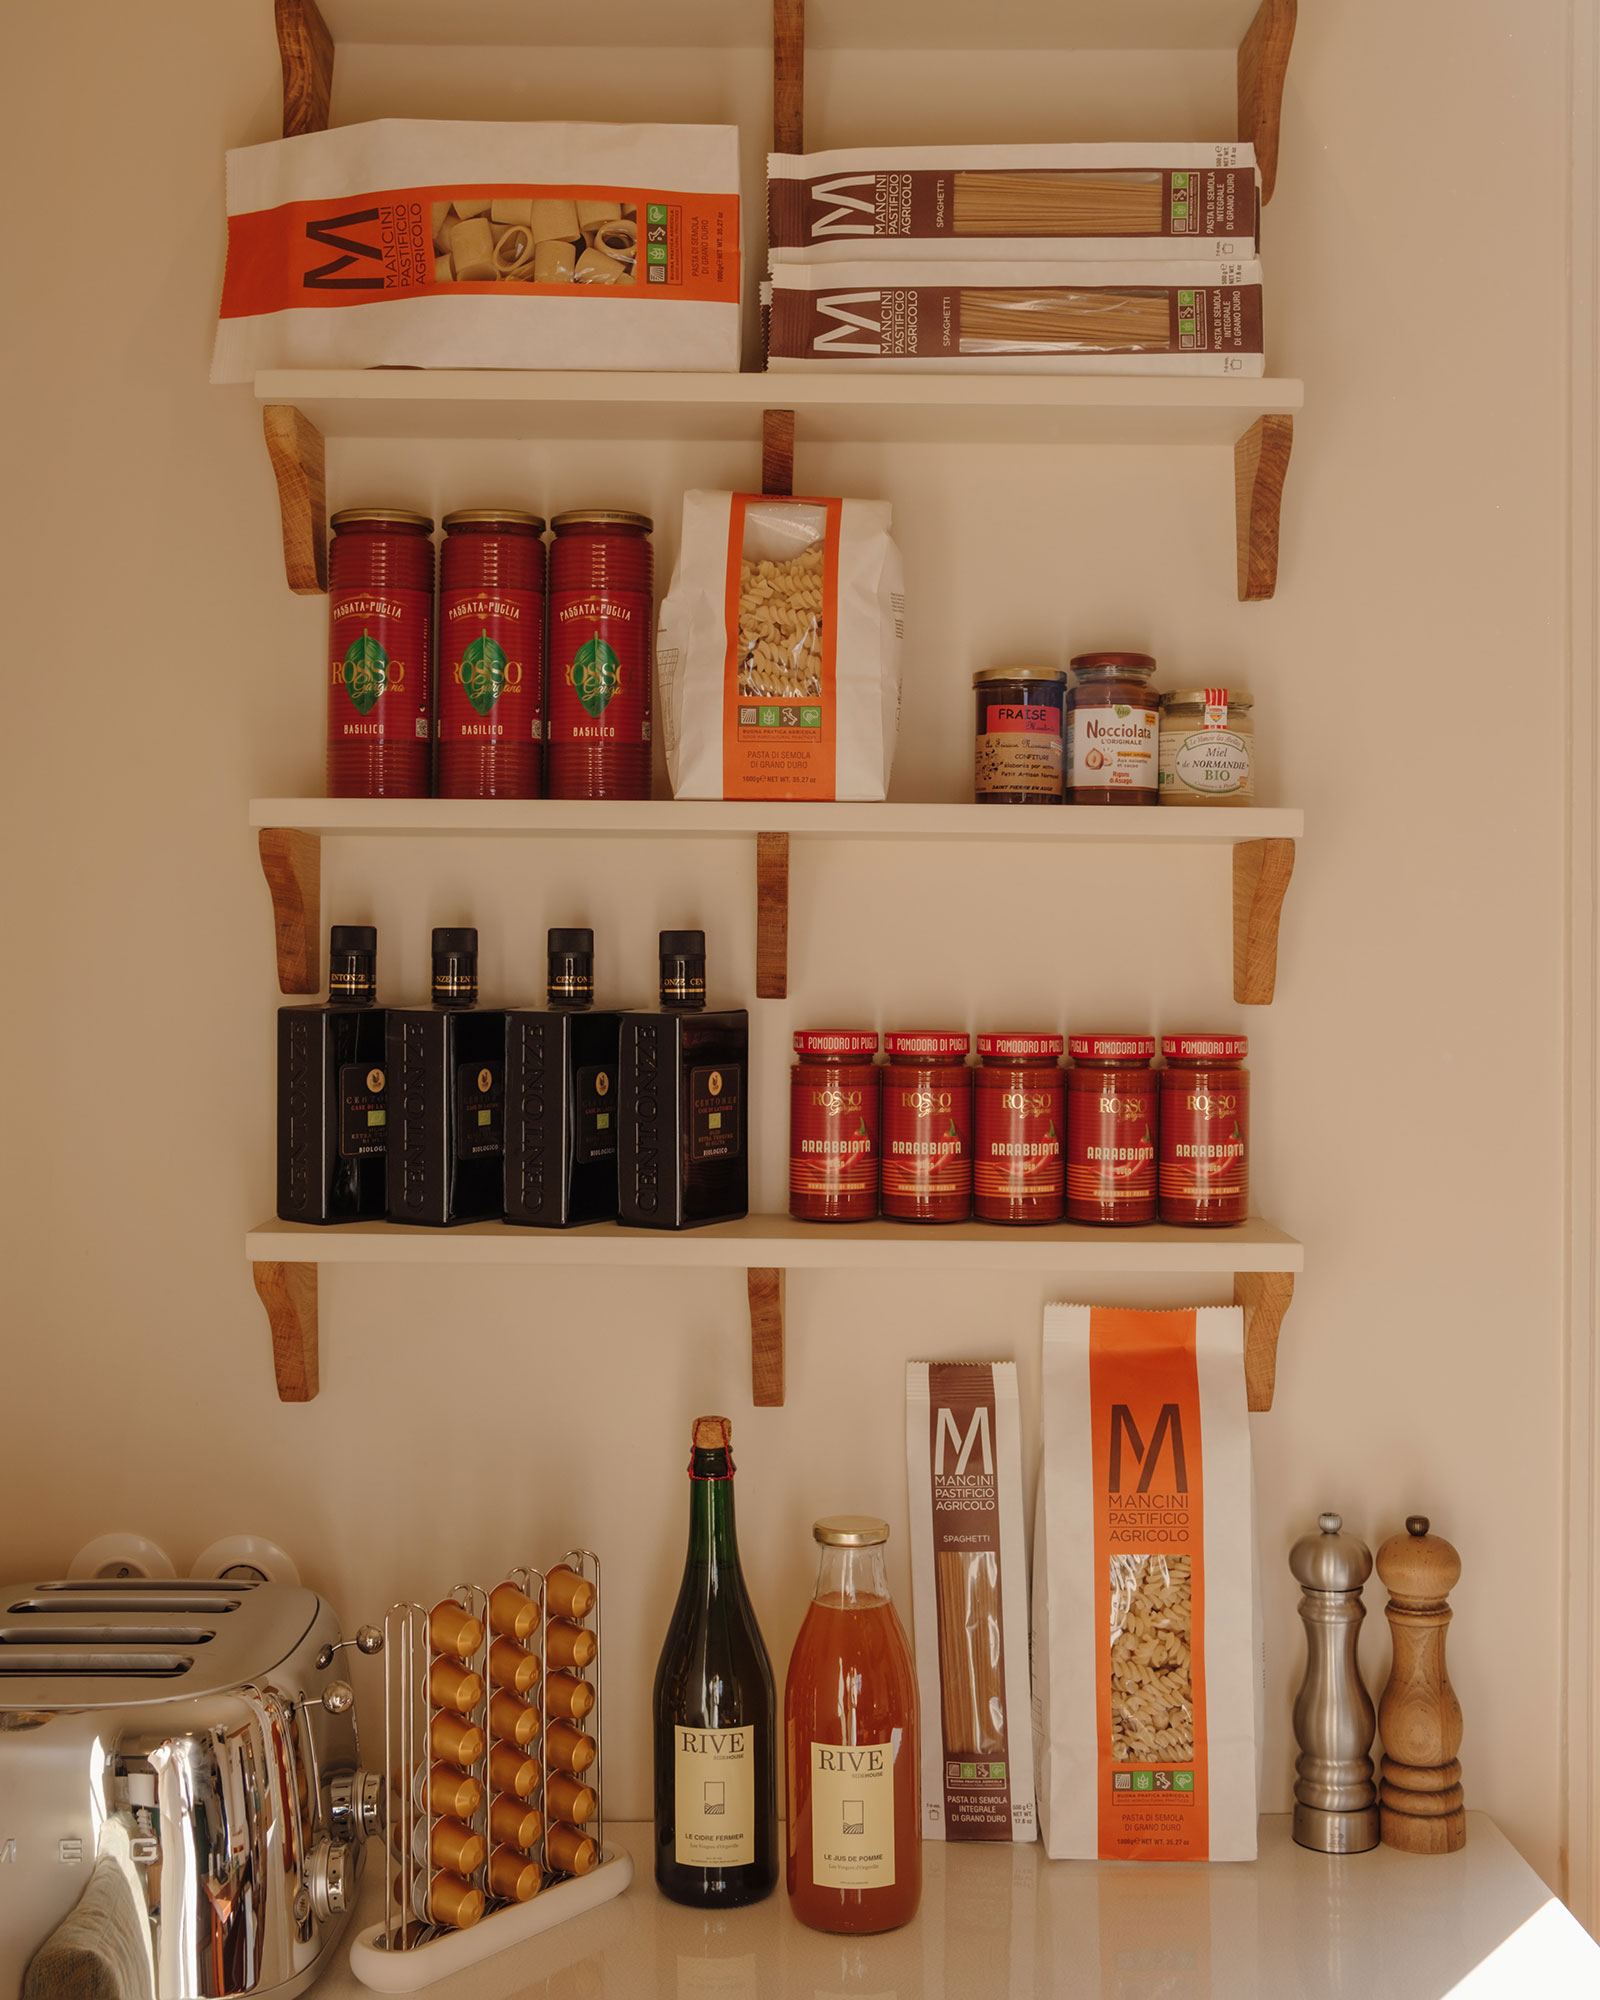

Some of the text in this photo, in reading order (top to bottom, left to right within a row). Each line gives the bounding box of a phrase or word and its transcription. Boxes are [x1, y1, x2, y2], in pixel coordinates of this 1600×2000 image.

[875, 174, 887, 234] MANCINI
[889, 174, 899, 234] PASTIFICIO
[901, 174, 912, 234] AGRICOLO
[936, 180, 944, 228] SPAGHETTI
[691, 216, 699, 246] SEMOLA
[380, 206, 398, 288] MANCINI
[395, 204, 410, 287] PASTIFICIO
[410, 203, 427, 284] AGRICOLO
[691, 256, 699, 277] PASTA
[881, 291, 892, 354] MANCINI
[895, 291, 904, 354] PASTIFICIO
[908, 291, 918, 353] AGRICOLO
[333, 601, 402, 620] PASSATA PUGLIA
[448, 602, 520, 620] PASSATA PUGLIA
[560, 604, 631, 621] PASSATA PUGLIA
[332, 660, 405, 684] ROSSO
[998, 708, 1046, 720] FRAISE
[344, 724, 385, 735] BASILICO
[462, 725, 503, 735] BASILICO
[573, 727, 615, 737] BASILICO
[1086, 720, 1151, 739] Nocciolata
[1206, 748, 1228, 757] Miel
[1192, 760, 1246, 770] NORMANDIE
[1205, 770, 1230, 781] BIO
[808, 1037, 859, 1050] POMODORO DI
[896, 1038, 947, 1051] POMODORO DI
[996, 1040, 1048, 1053] POMODORO DI
[1094, 1041, 1136, 1055] POMODORO
[1138, 1042, 1145, 1054] DI
[1181, 1041, 1233, 1054] POMODORO DI
[802, 1140, 870, 1152] ARRABBIATA
[892, 1141, 961, 1155] ARRABBIATA
[991, 1143, 1059, 1156] ARRABBIATA
[1176, 1144, 1244, 1157] ARRABBIATA
[1087, 1147, 1154, 1160] ARRABBIATA
[934, 1407, 994, 1475] M
[1108, 1403, 1188, 1493] M
[934, 1475, 994, 1486] MANCINI
[935, 1488, 994, 1498] PASTIFICIO
[936, 1500, 995, 1510] AGRICOLO
[1108, 1495, 1188, 1508] MANCINI
[1109, 1512, 1189, 1525] PASTIFICIO
[943, 1534, 990, 1543] SPAGHETTI
[1109, 1529, 1190, 1542] AGRICOLO
[681, 1731, 744, 1754] RIVE
[818, 1749, 884, 1772] RIVE
[948, 1796, 968, 1804] PASTA
